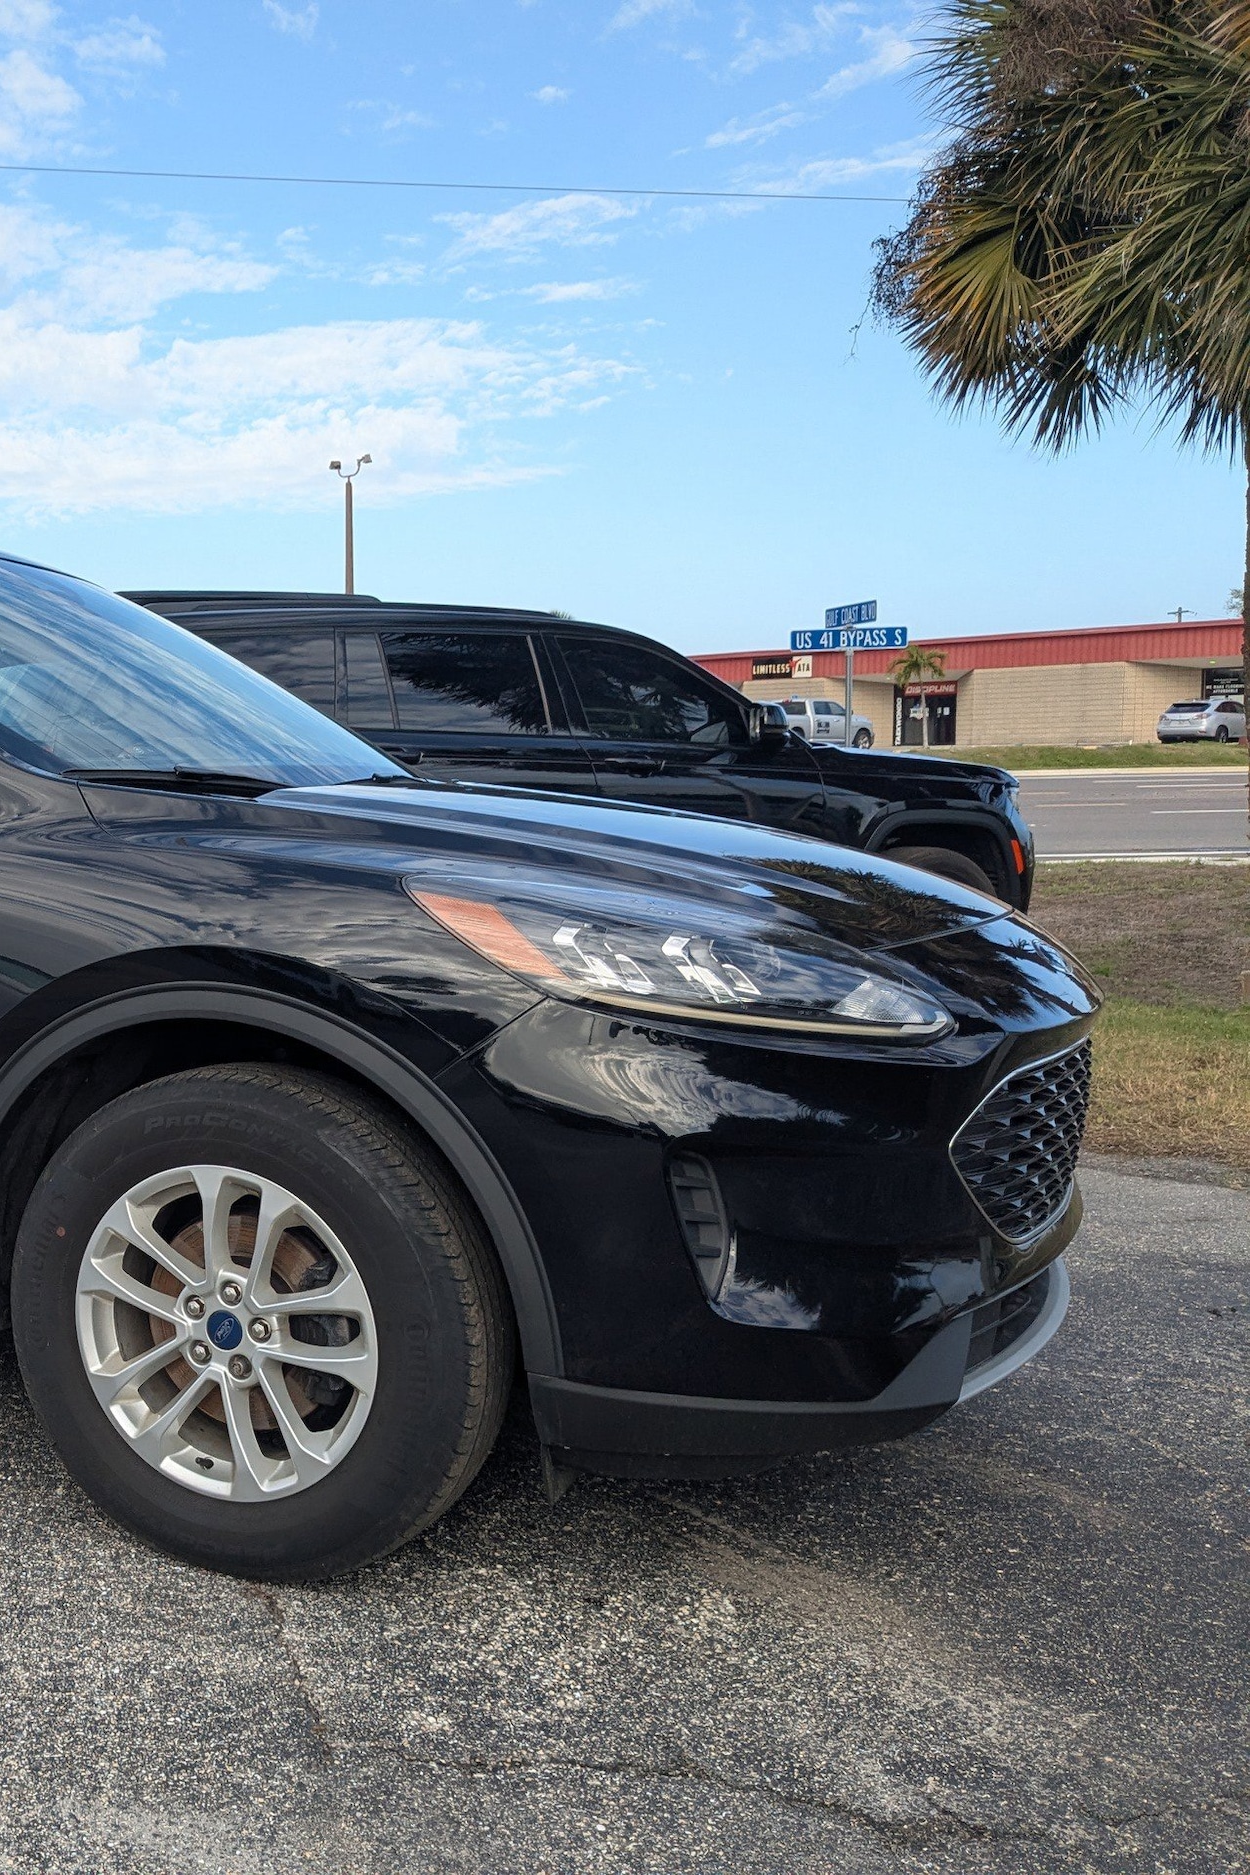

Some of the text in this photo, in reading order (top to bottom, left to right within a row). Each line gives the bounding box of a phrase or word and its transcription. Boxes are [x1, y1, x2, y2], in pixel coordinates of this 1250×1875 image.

[826, 602, 876, 627] GULF COAST BLVD
[796, 629, 902, 649] US 41 BYPASS S
[752, 663, 790, 675] LIMITLESS
